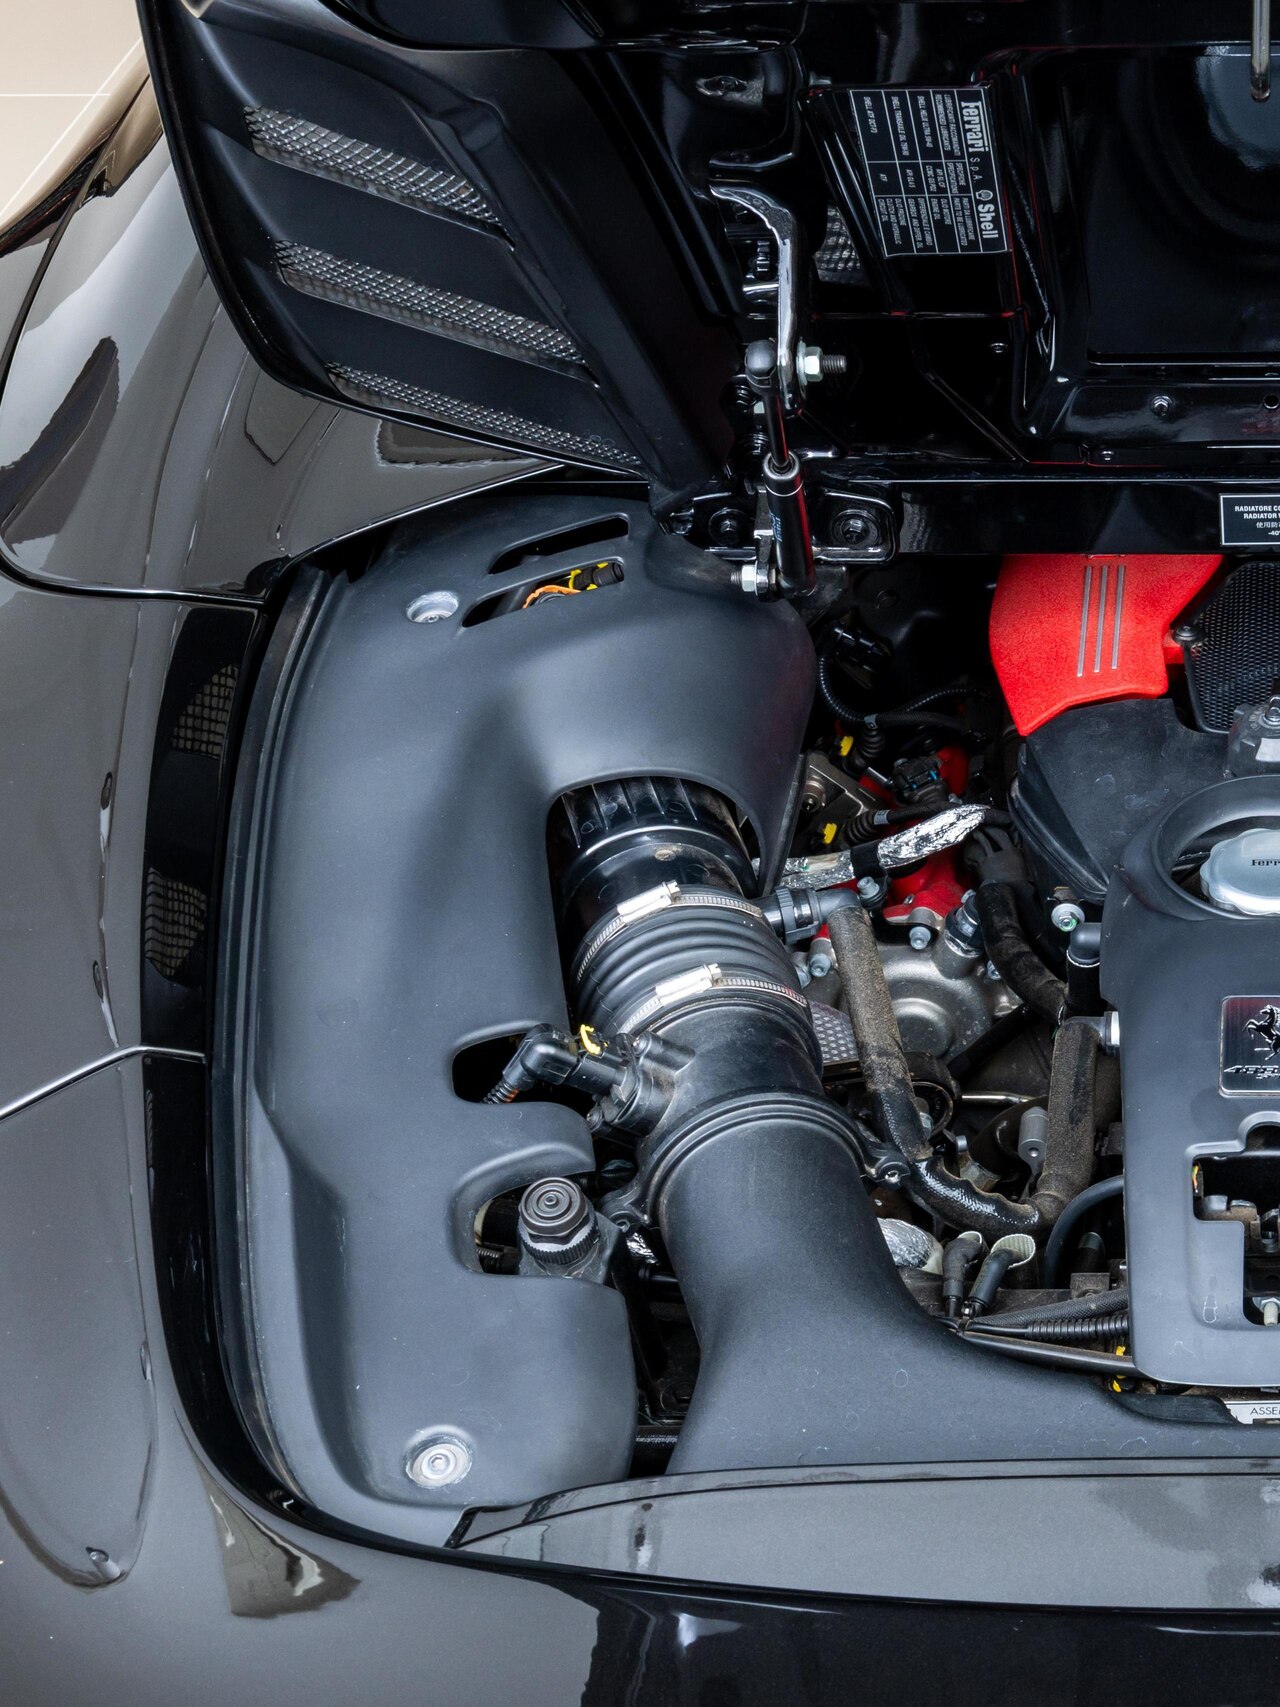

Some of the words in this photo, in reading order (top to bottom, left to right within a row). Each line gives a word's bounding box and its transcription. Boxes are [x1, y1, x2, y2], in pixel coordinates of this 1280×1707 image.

[960, 101, 988, 152] Ferrari
[968, 157, 983, 182] S.p.A.
[977, 203, 999, 238] Shell
